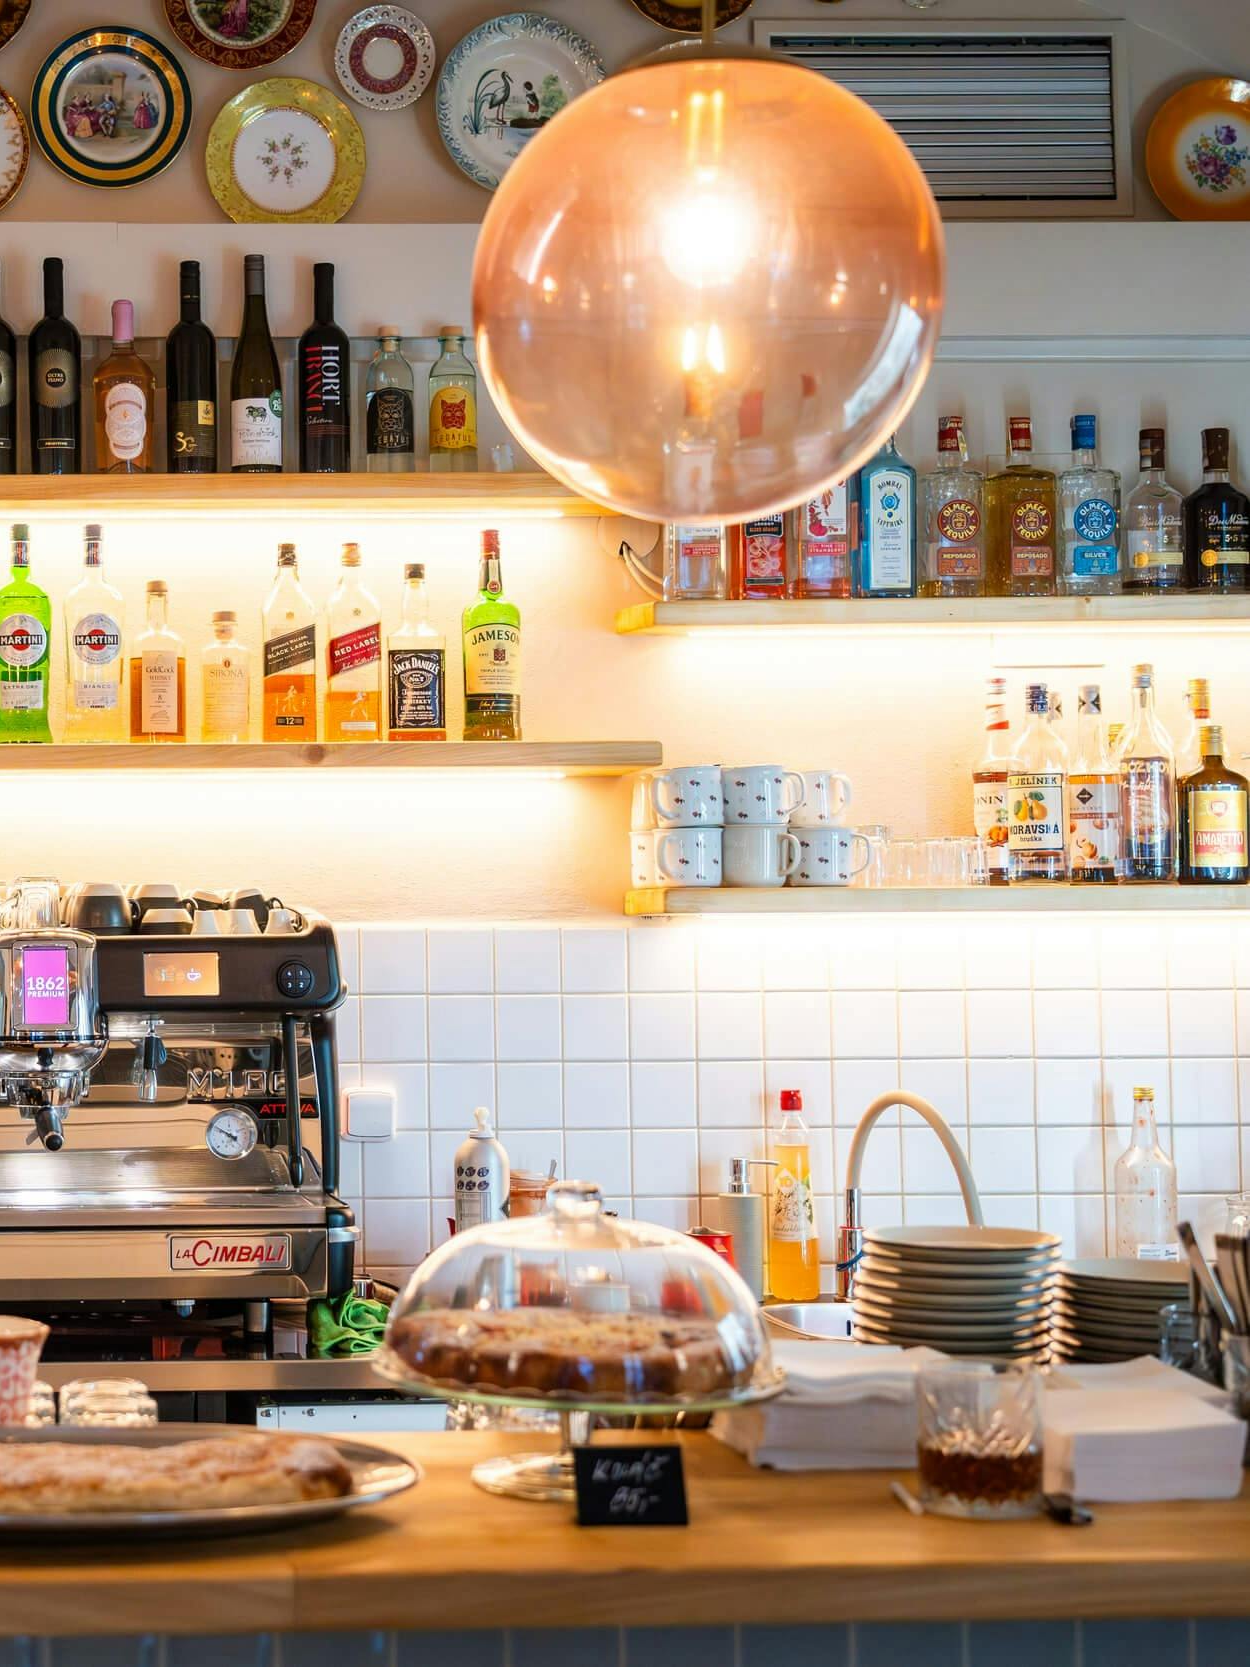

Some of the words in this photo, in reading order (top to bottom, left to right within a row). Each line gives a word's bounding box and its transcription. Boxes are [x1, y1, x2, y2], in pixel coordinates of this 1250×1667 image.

[877, 480, 902, 490] BOMBAY
[943, 503, 975, 517] OLMECA
[1016, 503, 1047, 517] OLMECA
[1079, 502, 1110, 516] OLMECA
[943, 524, 977, 539] TEQUILA
[1016, 524, 1049, 539] TEQUILA
[1079, 524, 1112, 538] TEQUILA
[0, 636, 42, 645] MARTINI
[76, 635, 117, 645] MARTINI
[334, 646, 352, 657] RED
[353, 636, 380, 650] LABEL
[267, 648, 289, 659] BLACK
[393, 660, 411, 675] JACK
[285, 717, 295, 725] 12
[1015, 775, 1057, 785] JELÍNEK
[1196, 831, 1244, 846] AMARETTO
[26, 976, 65, 991] 1862
[27, 990, 65, 998] PREMIUM
[175, 1249, 190, 1259] LA
[191, 1239, 285, 1267] CIMBALI
